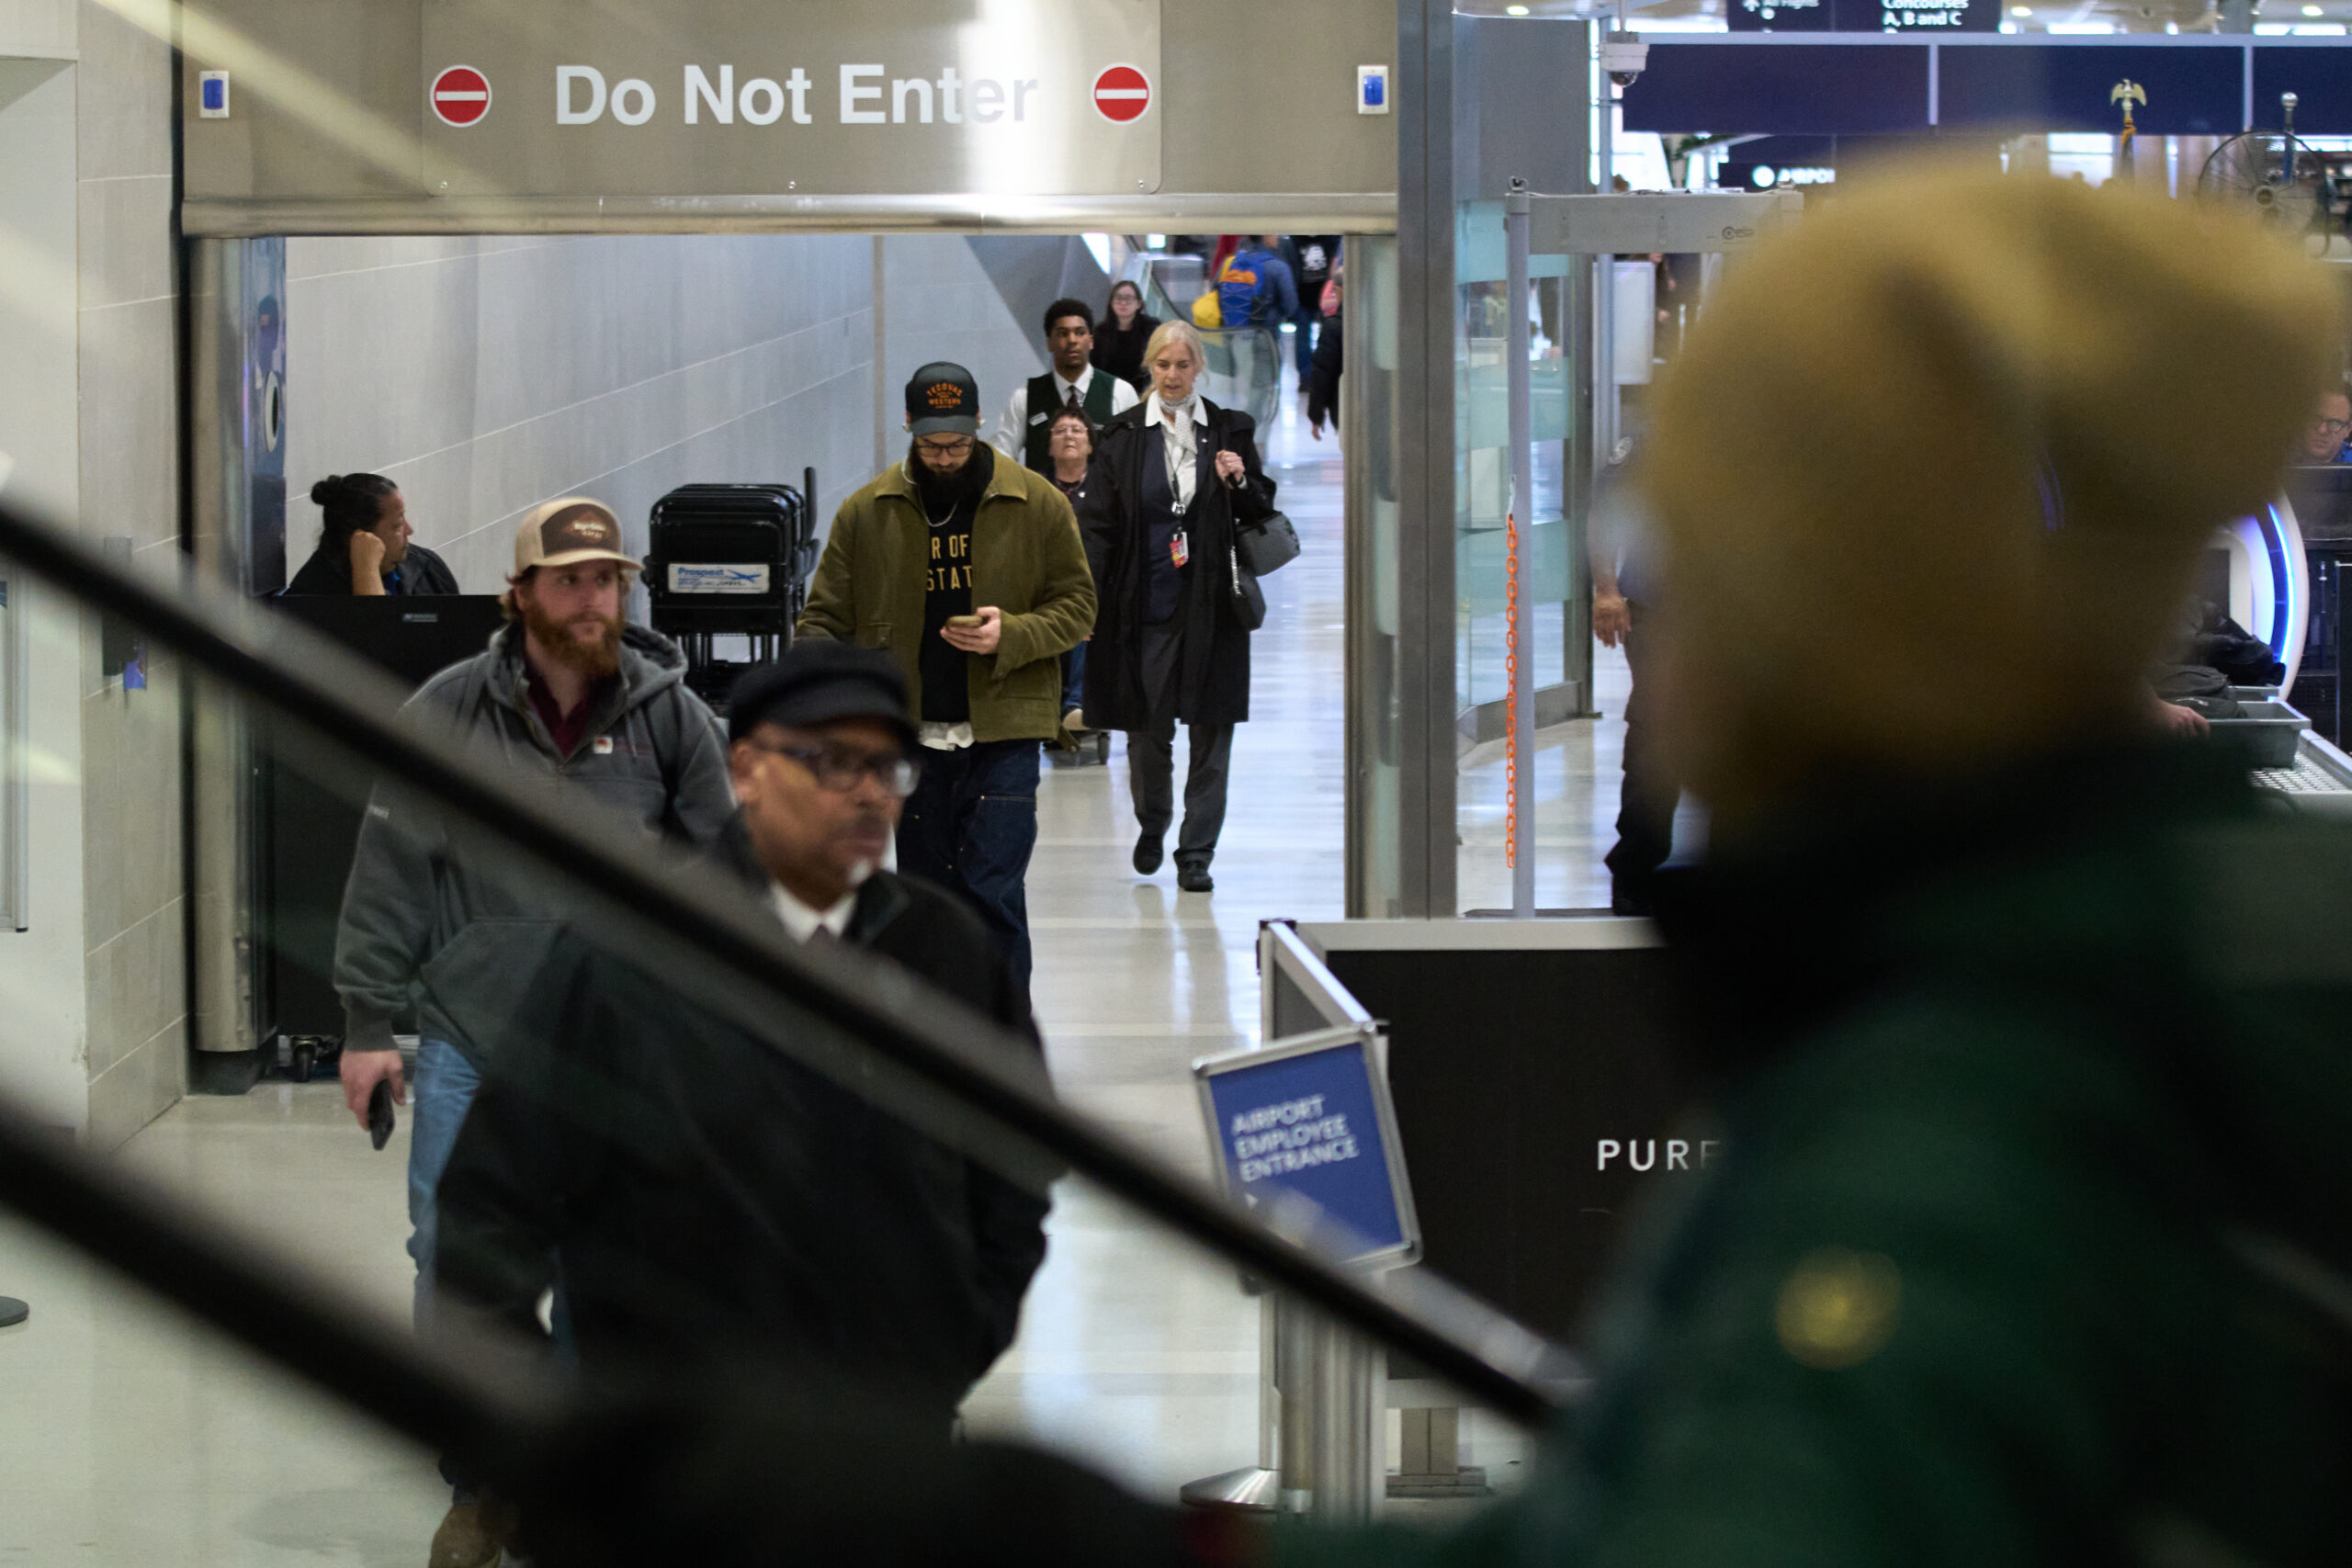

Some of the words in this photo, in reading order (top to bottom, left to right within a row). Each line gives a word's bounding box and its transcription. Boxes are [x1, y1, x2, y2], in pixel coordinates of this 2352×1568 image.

[1903, 10, 1916, 26] B
[1917, 10, 1947, 26] and
[1949, 10, 1962, 26] C
[556, 64, 656, 126] Do
[684, 63, 813, 126] Not
[840, 63, 1038, 125] Enter
[1777, 167, 1836, 184] AIRPO
[948, 534, 969, 558] OF
[1231, 1093, 1326, 1136] AIRPORT
[1234, 1111, 1349, 1160] EMPLOYEE
[1239, 1134, 1360, 1182] ENTRANCE
